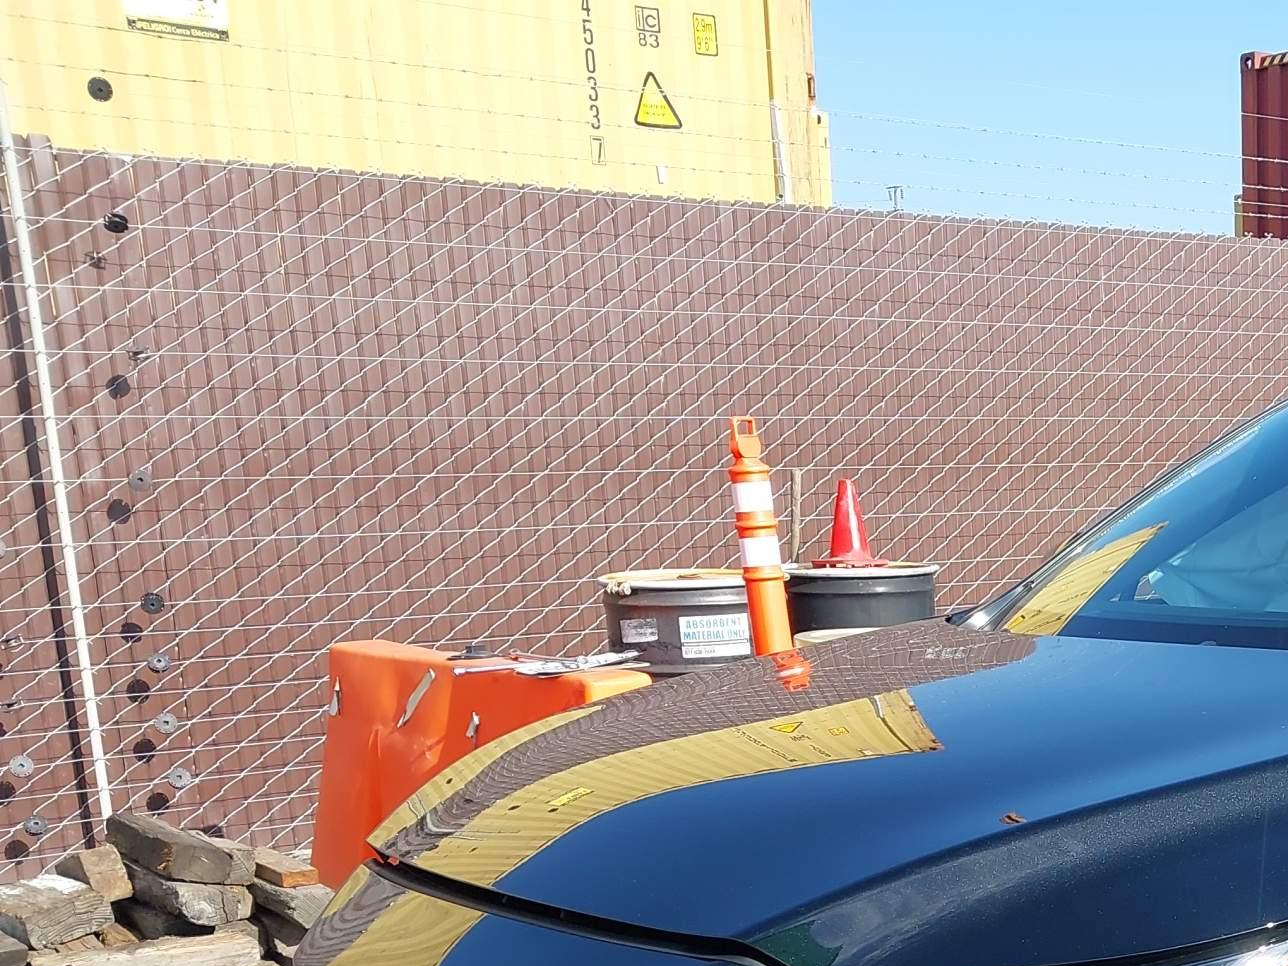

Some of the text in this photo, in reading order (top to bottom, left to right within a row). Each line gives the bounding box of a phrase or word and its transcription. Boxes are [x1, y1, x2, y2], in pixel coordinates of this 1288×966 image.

[638, 32, 660, 48] 83
[683, 629, 747, 641] MATERIAL ONLY
